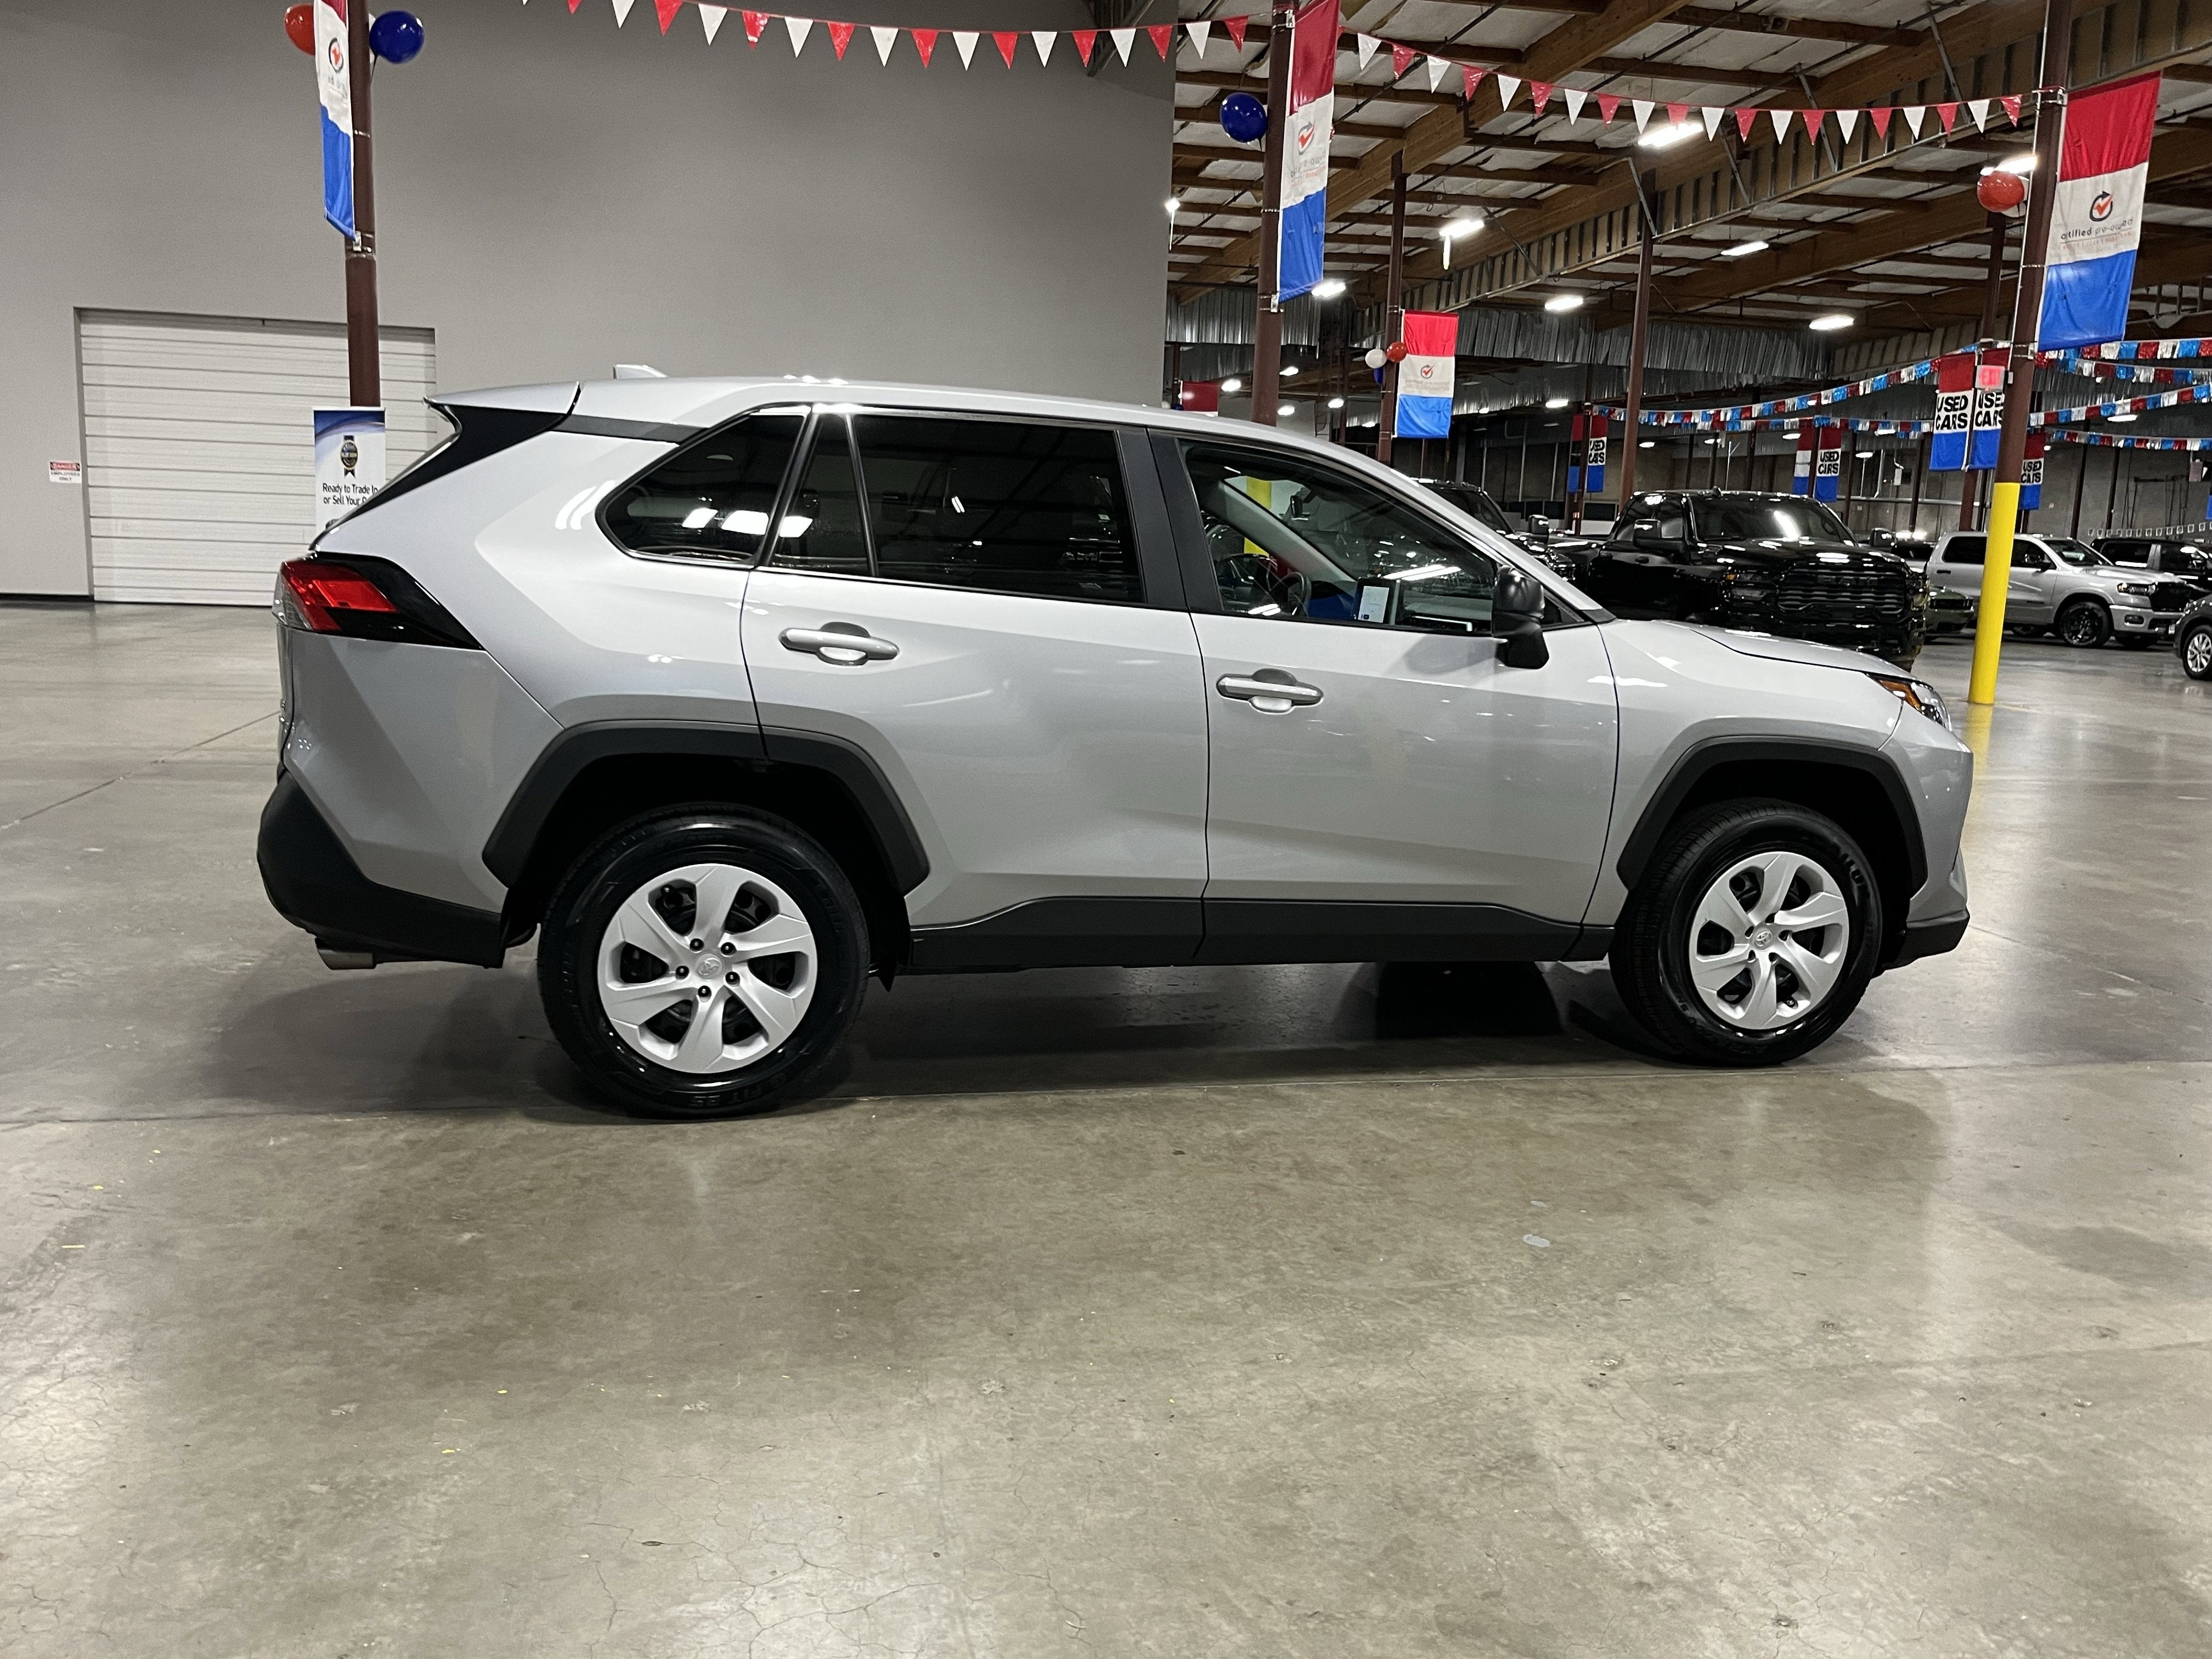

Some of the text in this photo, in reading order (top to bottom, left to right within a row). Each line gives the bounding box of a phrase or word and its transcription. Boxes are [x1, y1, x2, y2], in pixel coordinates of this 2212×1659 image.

[2061, 227, 2092, 240] ctified
[1937, 395, 1969, 413] USED
[1978, 392, 2004, 408] USE
[1936, 413, 1968, 430] CARS
[1820, 451, 1839, 462] USED
[2023, 460, 2042, 472] USED
[323, 483, 342, 495] Ready
[345, 484, 351, 493] to
[351, 483, 370, 494] Trade
[332, 495, 345, 505] Sell
[346, 495, 361, 506] Your
